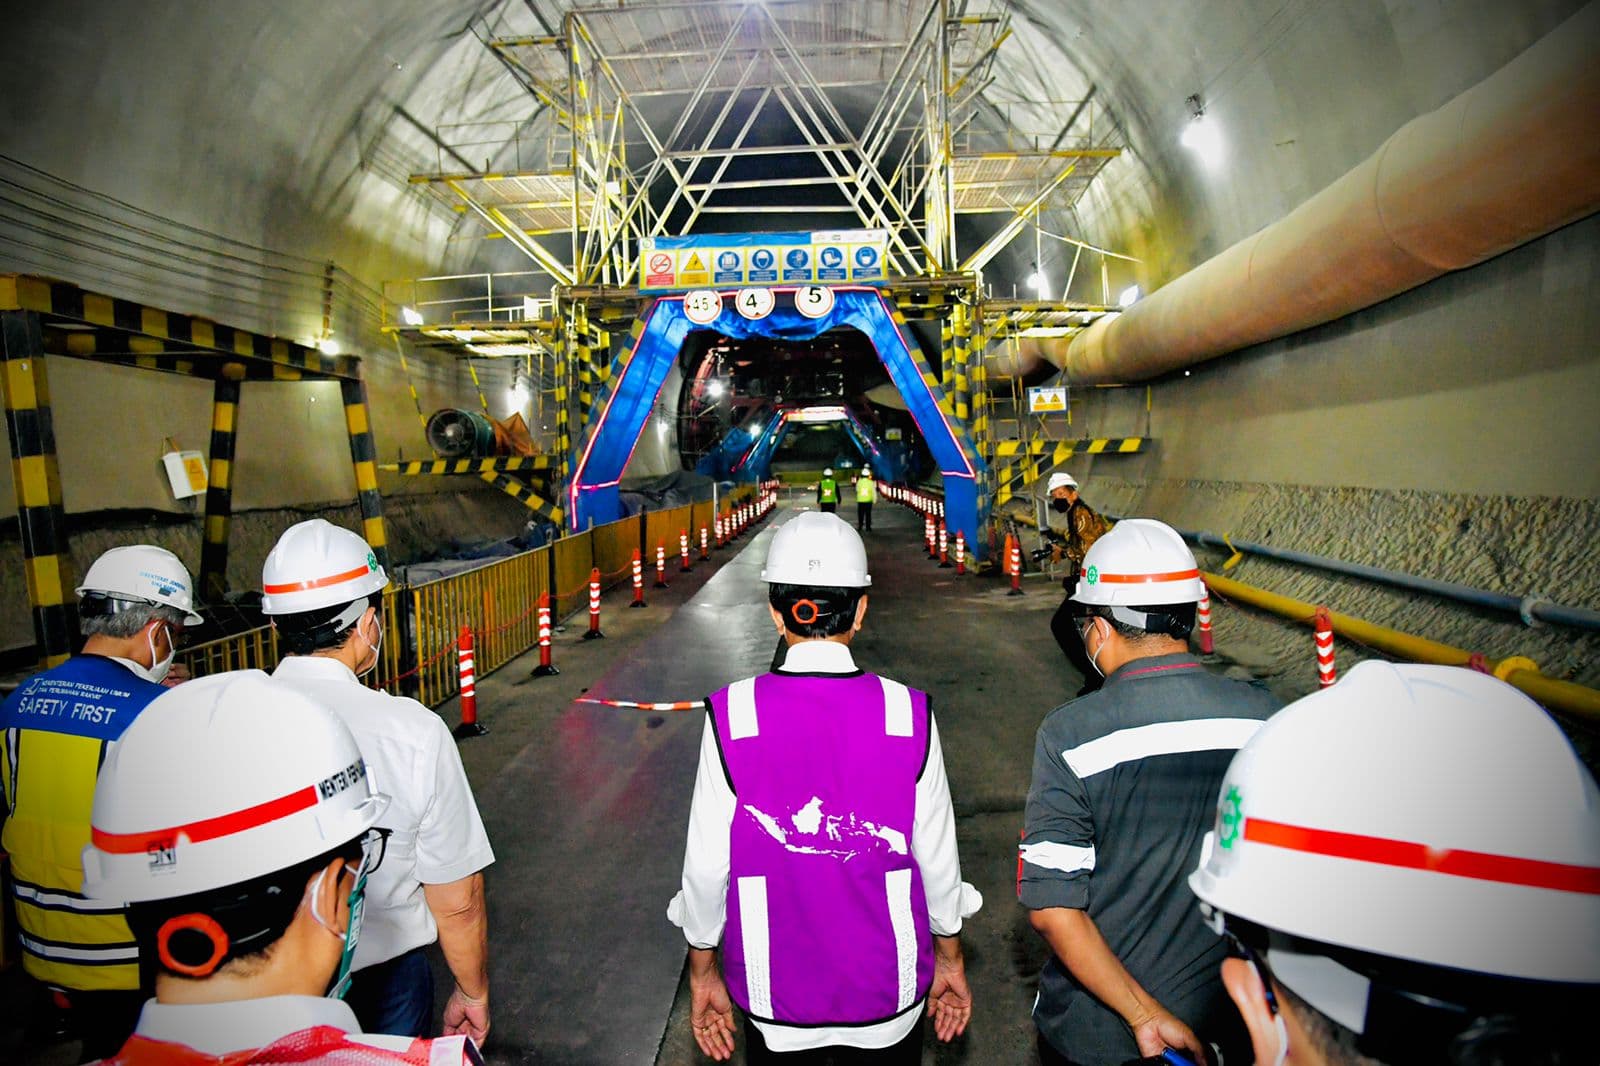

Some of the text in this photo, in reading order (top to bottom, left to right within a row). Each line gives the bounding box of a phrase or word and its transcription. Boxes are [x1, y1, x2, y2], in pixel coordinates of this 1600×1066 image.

[745, 293, 758, 308] 4
[808, 287, 822, 304] 5
[18, 697, 117, 725] SAFETY FIRST
[318, 771, 349, 800] MENTERI
